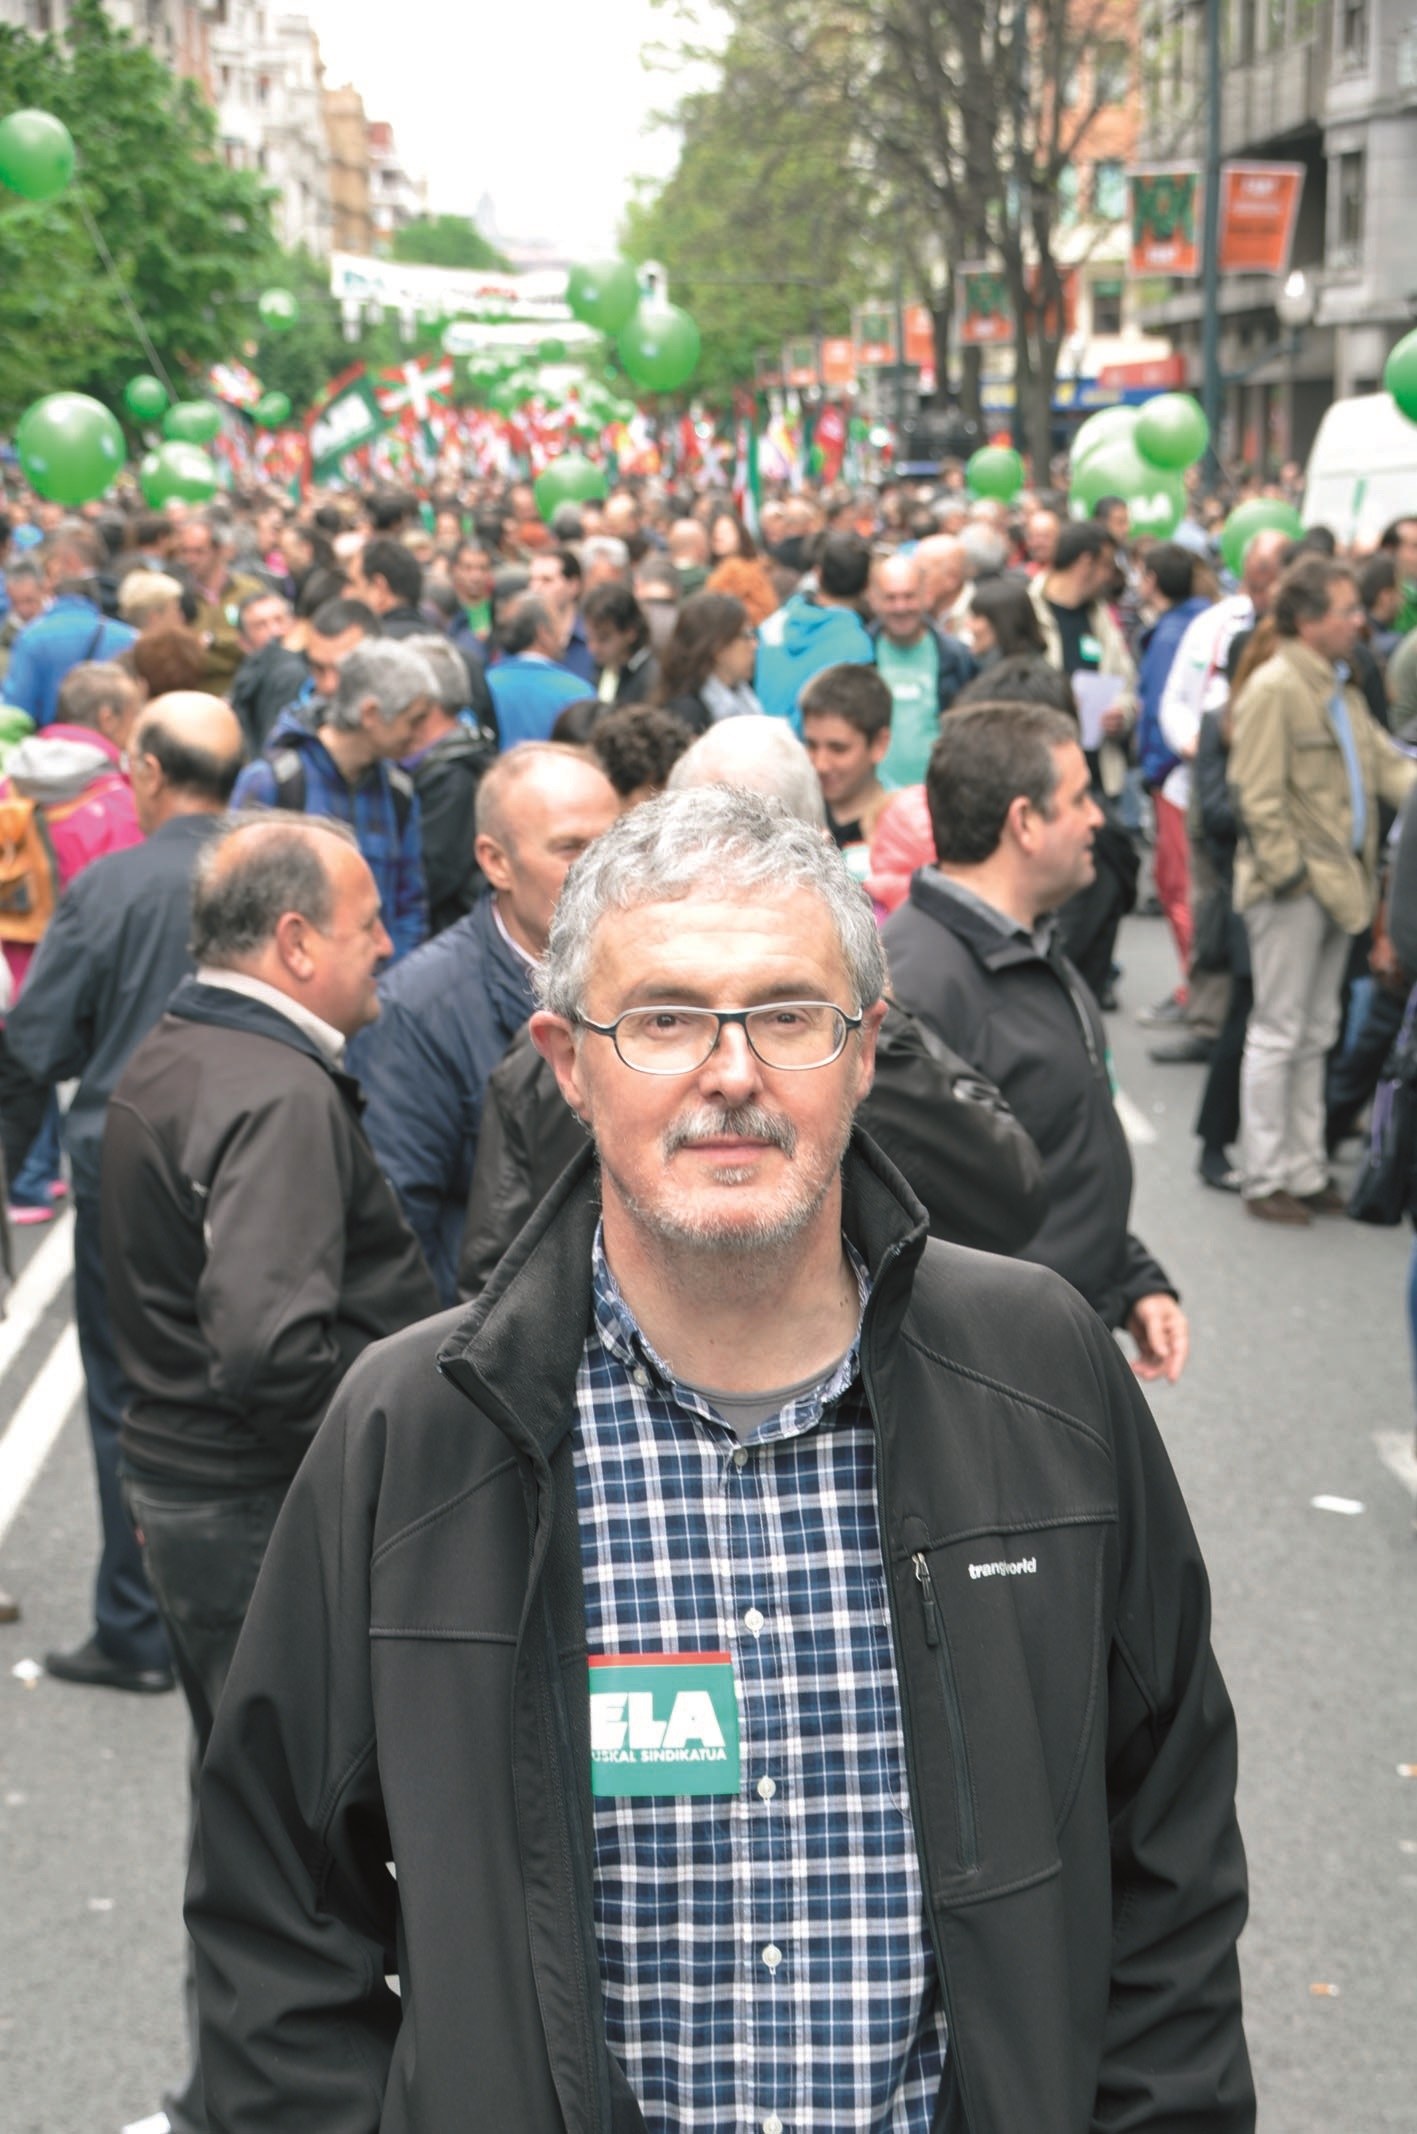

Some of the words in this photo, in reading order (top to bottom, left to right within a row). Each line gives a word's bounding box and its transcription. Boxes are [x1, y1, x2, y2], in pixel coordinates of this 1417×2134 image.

[590, 1691, 726, 1749] ELA
[591, 1750, 637, 1762] USKAL
[641, 1748, 727, 1762] SINDIKATUA
